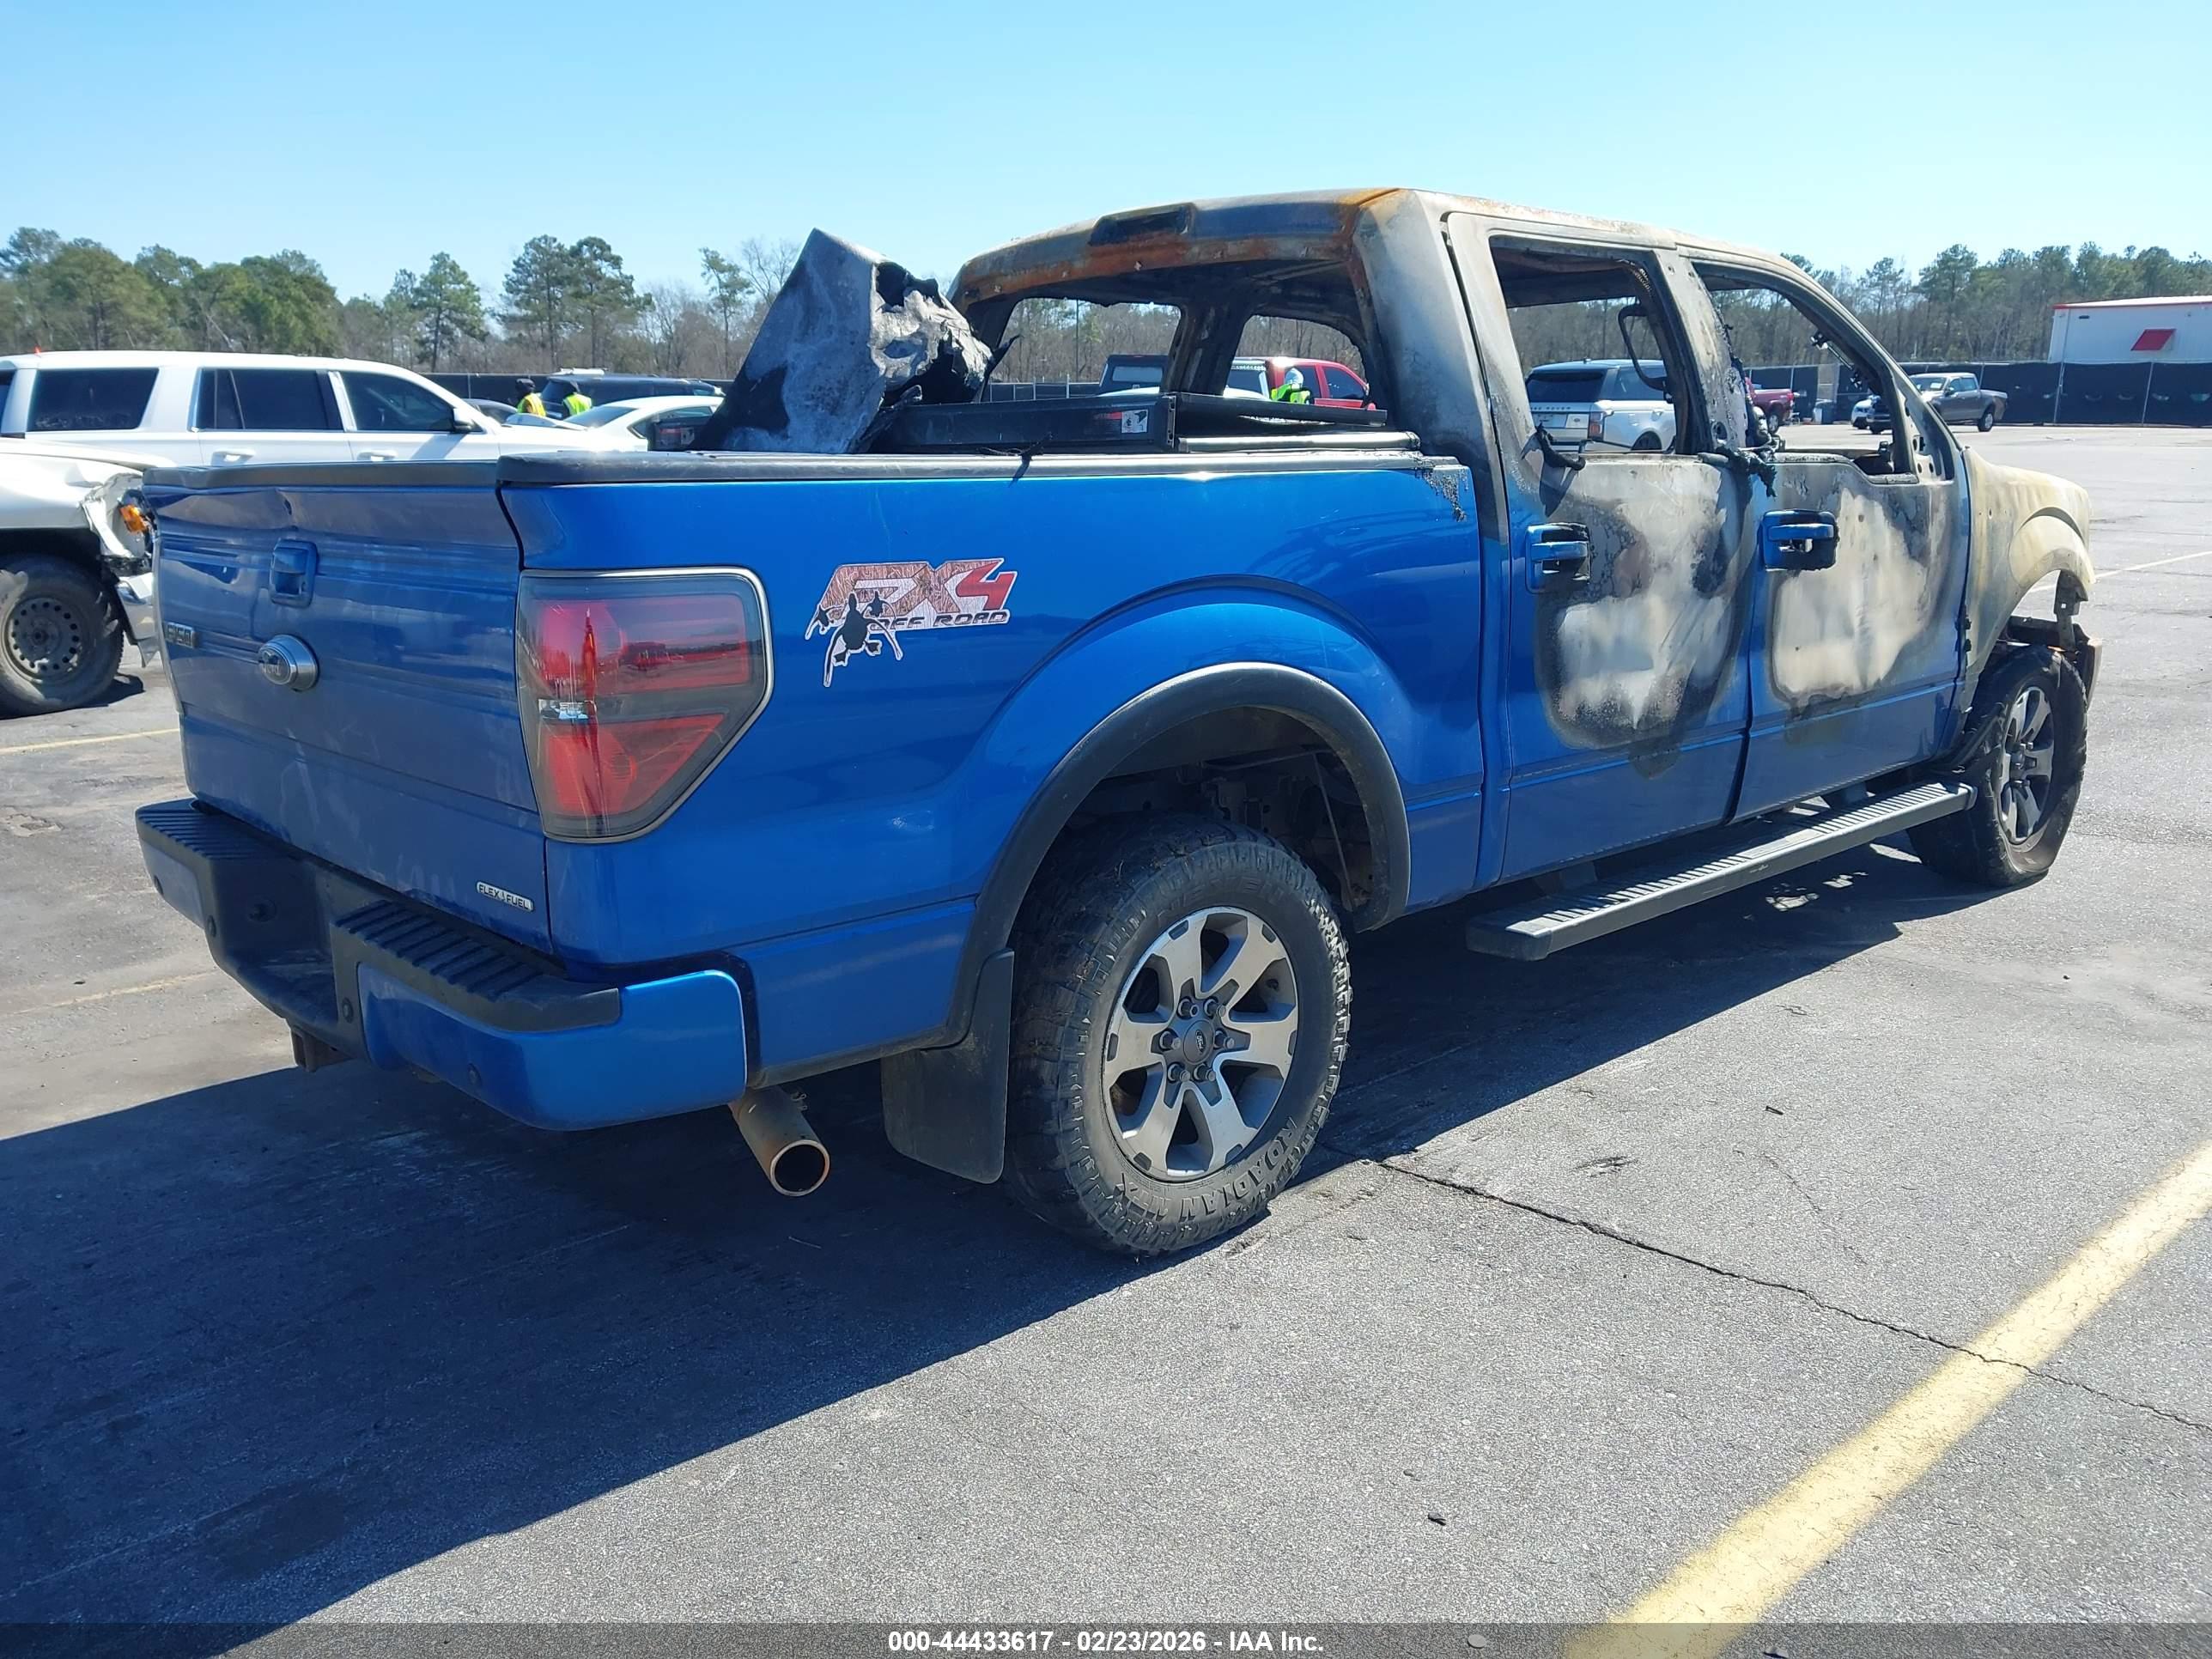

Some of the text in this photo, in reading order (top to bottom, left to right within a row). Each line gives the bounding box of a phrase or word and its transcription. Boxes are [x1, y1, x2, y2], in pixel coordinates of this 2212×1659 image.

[819, 560, 1017, 617] FX4
[933, 611, 1008, 627] ROAD
[478, 884, 530, 910] FLEX FUEL
